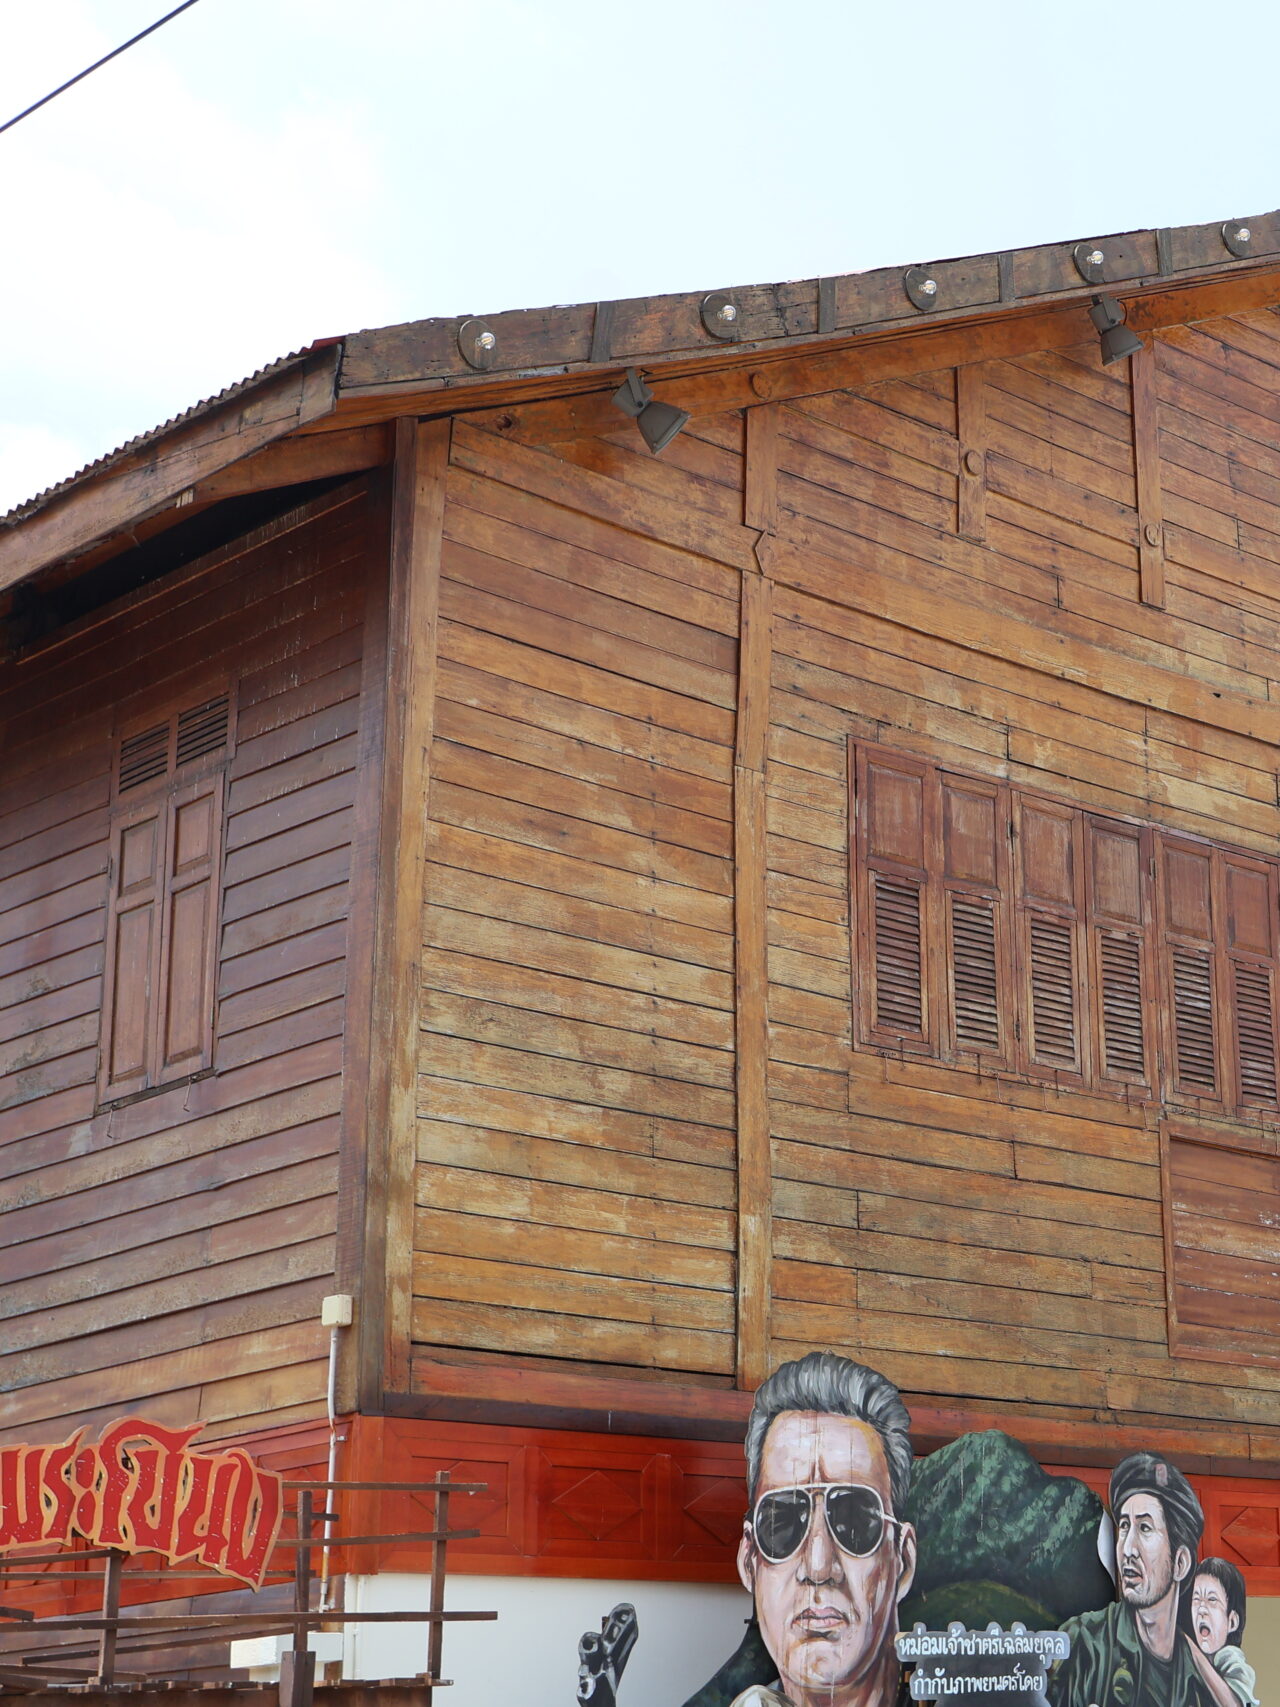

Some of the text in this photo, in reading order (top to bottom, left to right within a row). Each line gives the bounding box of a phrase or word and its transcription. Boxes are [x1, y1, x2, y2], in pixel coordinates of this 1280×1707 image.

[898, 1627, 1065, 1665] หม่อมเจ้าชาตรีเฉลิมยุคล
[913, 1662, 1043, 1695] กำกับภาพยนตร์โดย
